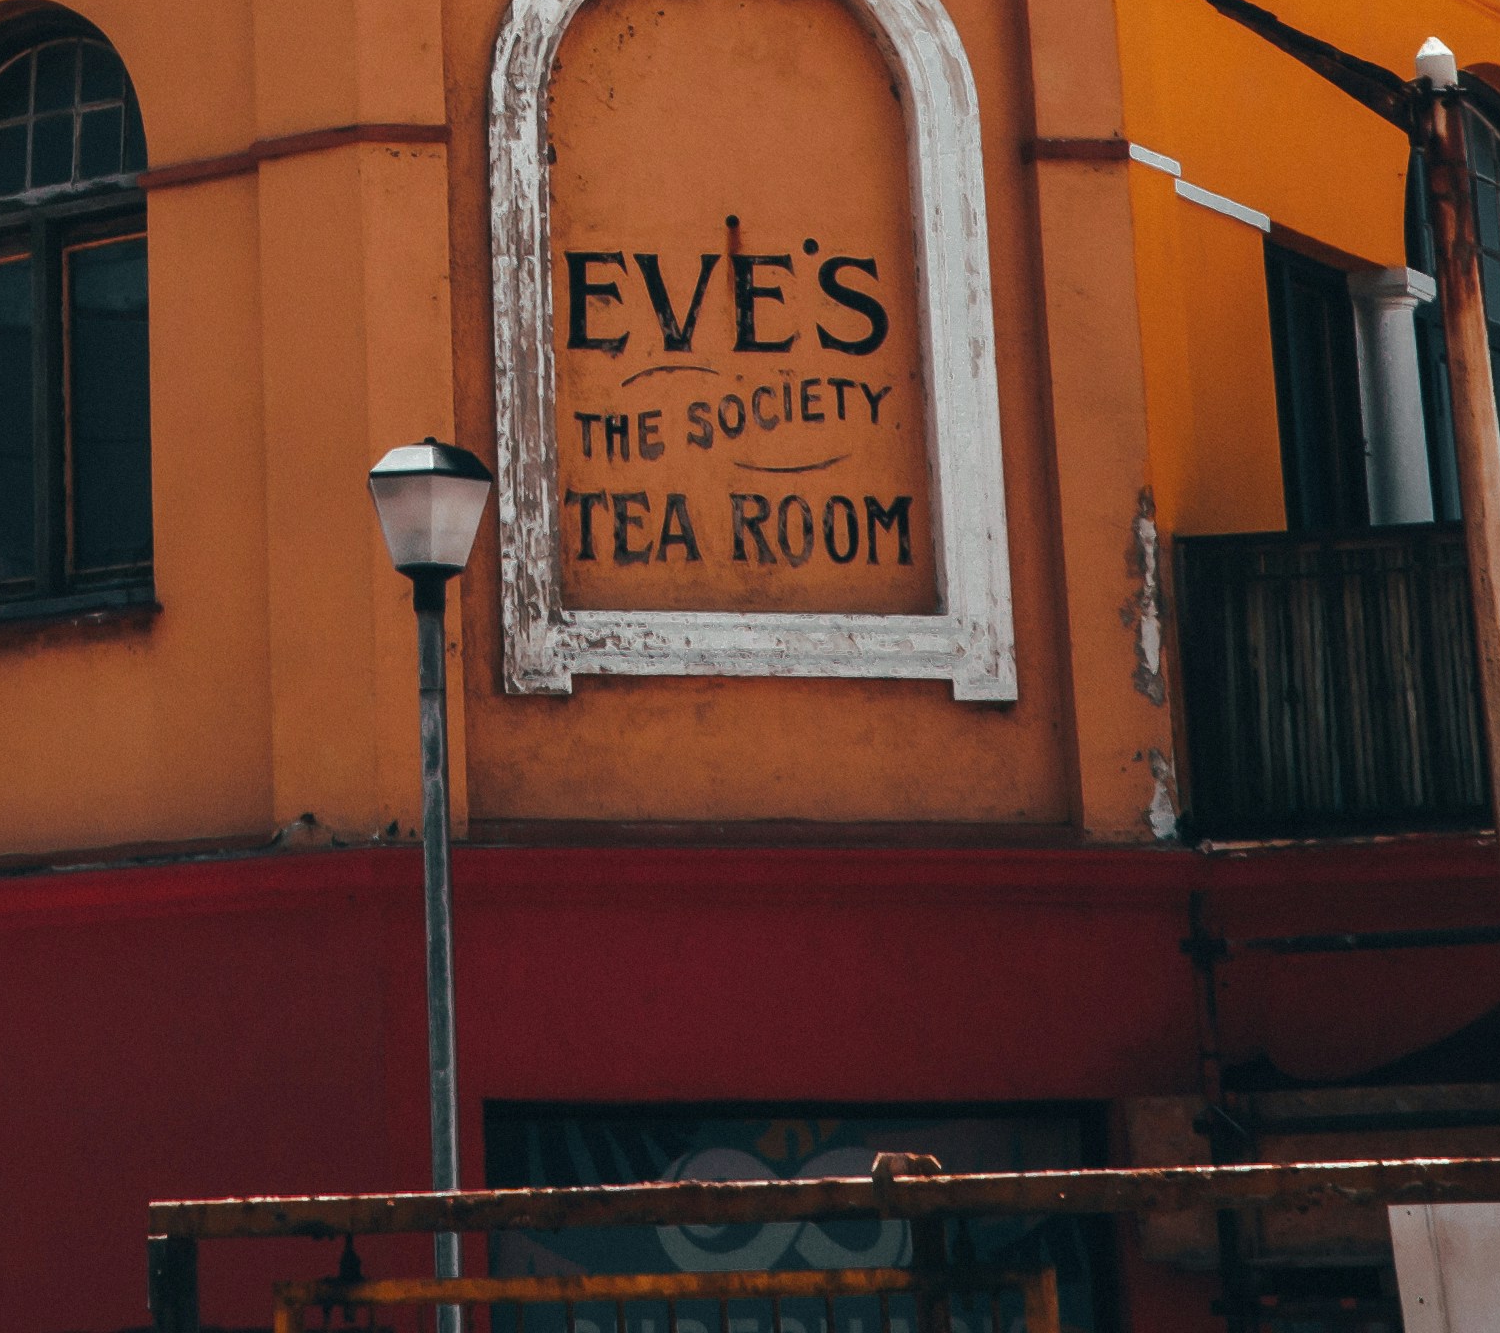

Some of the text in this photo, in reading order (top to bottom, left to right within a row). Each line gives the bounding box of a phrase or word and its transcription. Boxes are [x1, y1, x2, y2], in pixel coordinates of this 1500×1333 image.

[574, 377, 893, 463] THE SOCIETY
[563, 487, 915, 567] TEA ROOM
